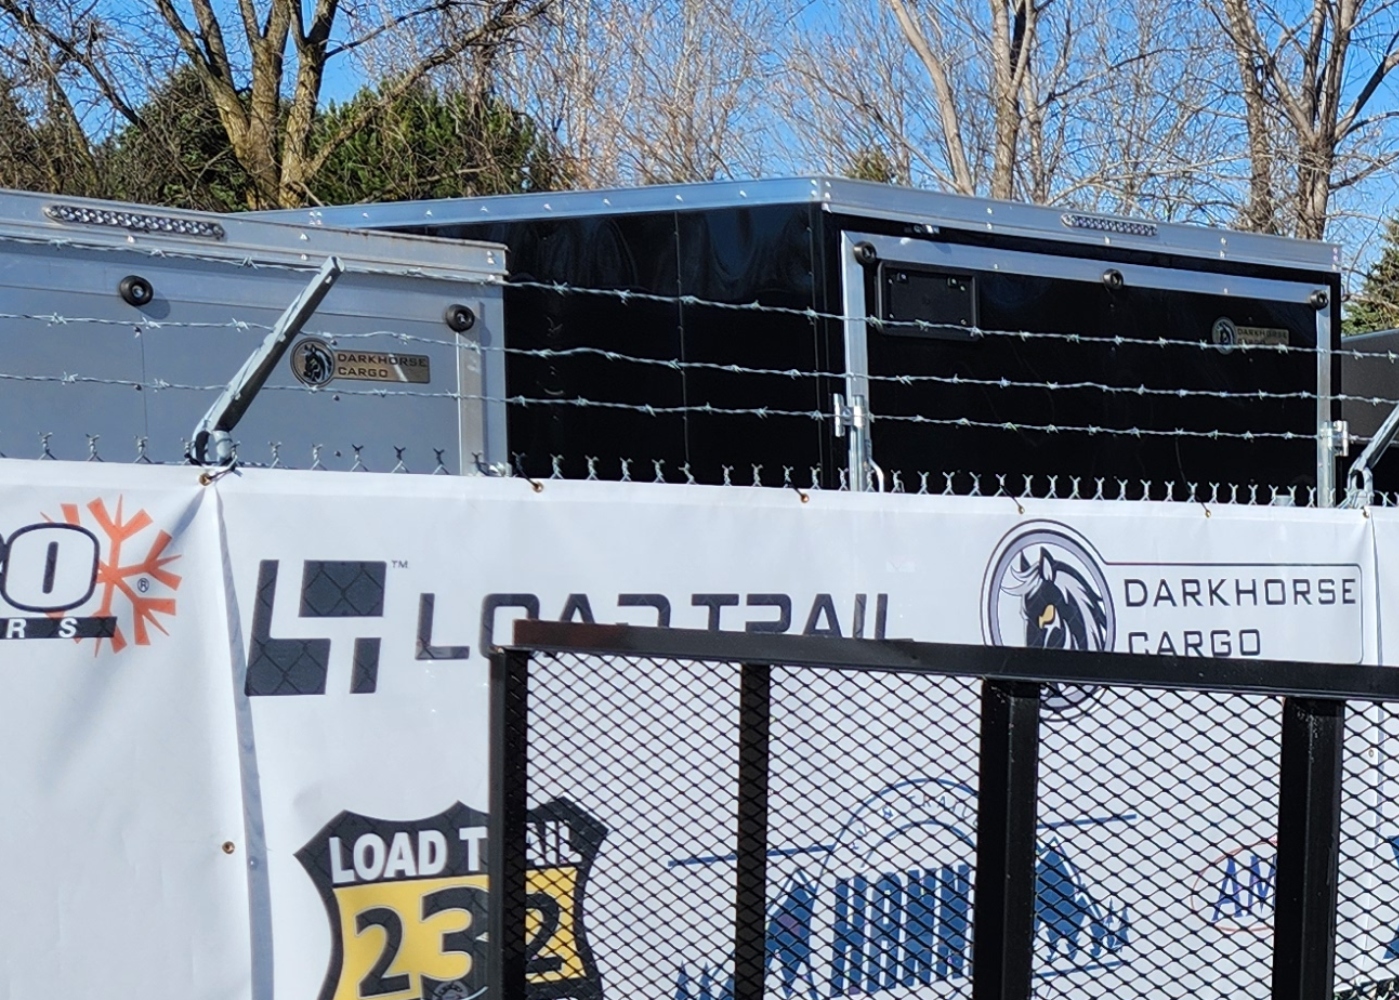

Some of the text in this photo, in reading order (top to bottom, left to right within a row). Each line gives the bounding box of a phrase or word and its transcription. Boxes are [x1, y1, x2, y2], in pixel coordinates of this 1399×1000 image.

[337, 353, 427, 367] DARKHORSE
[338, 366, 388, 378] CARGO
[0, 522, 99, 613] O
[1123, 578, 1356, 607] DARKHORSE
[1128, 628, 1261, 657] CARGO
[329, 819, 583, 884] LOAD TAIL
[829, 864, 974, 998] HANN
